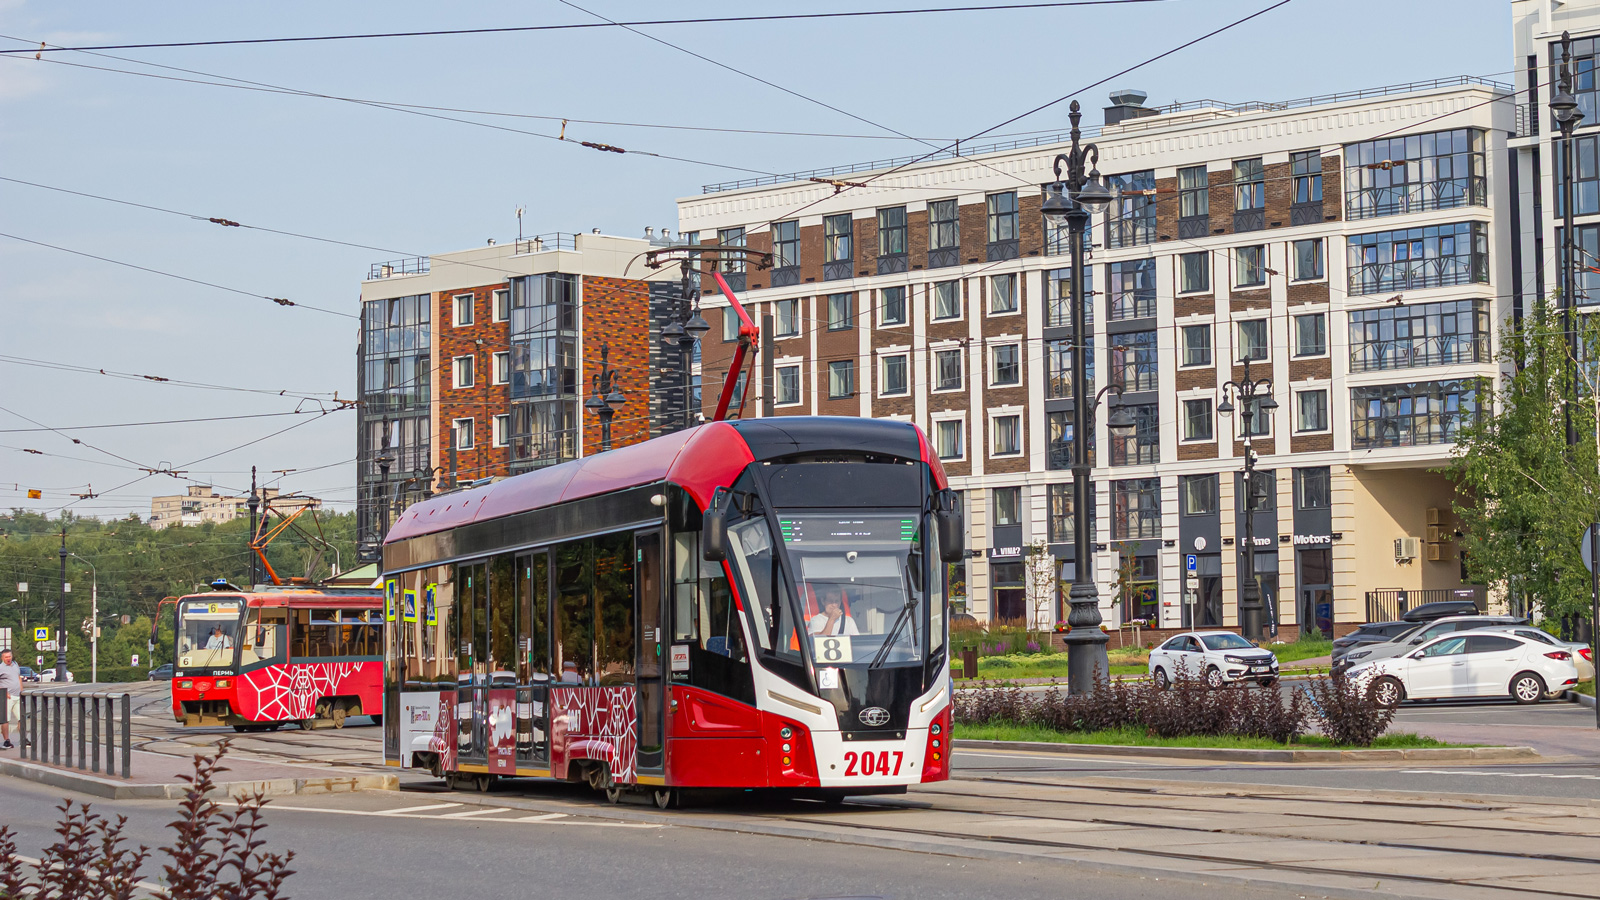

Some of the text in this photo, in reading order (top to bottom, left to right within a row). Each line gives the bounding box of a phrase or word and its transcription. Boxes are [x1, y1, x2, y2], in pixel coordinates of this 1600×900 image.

[1241, 534, 1331, 547] Pime Motors
[210, 603, 216, 613] 6
[823, 638, 843, 661] 8
[183, 657, 189, 666] 6
[567, 709, 581, 732] 2047
[844, 750, 904, 777] 2047
